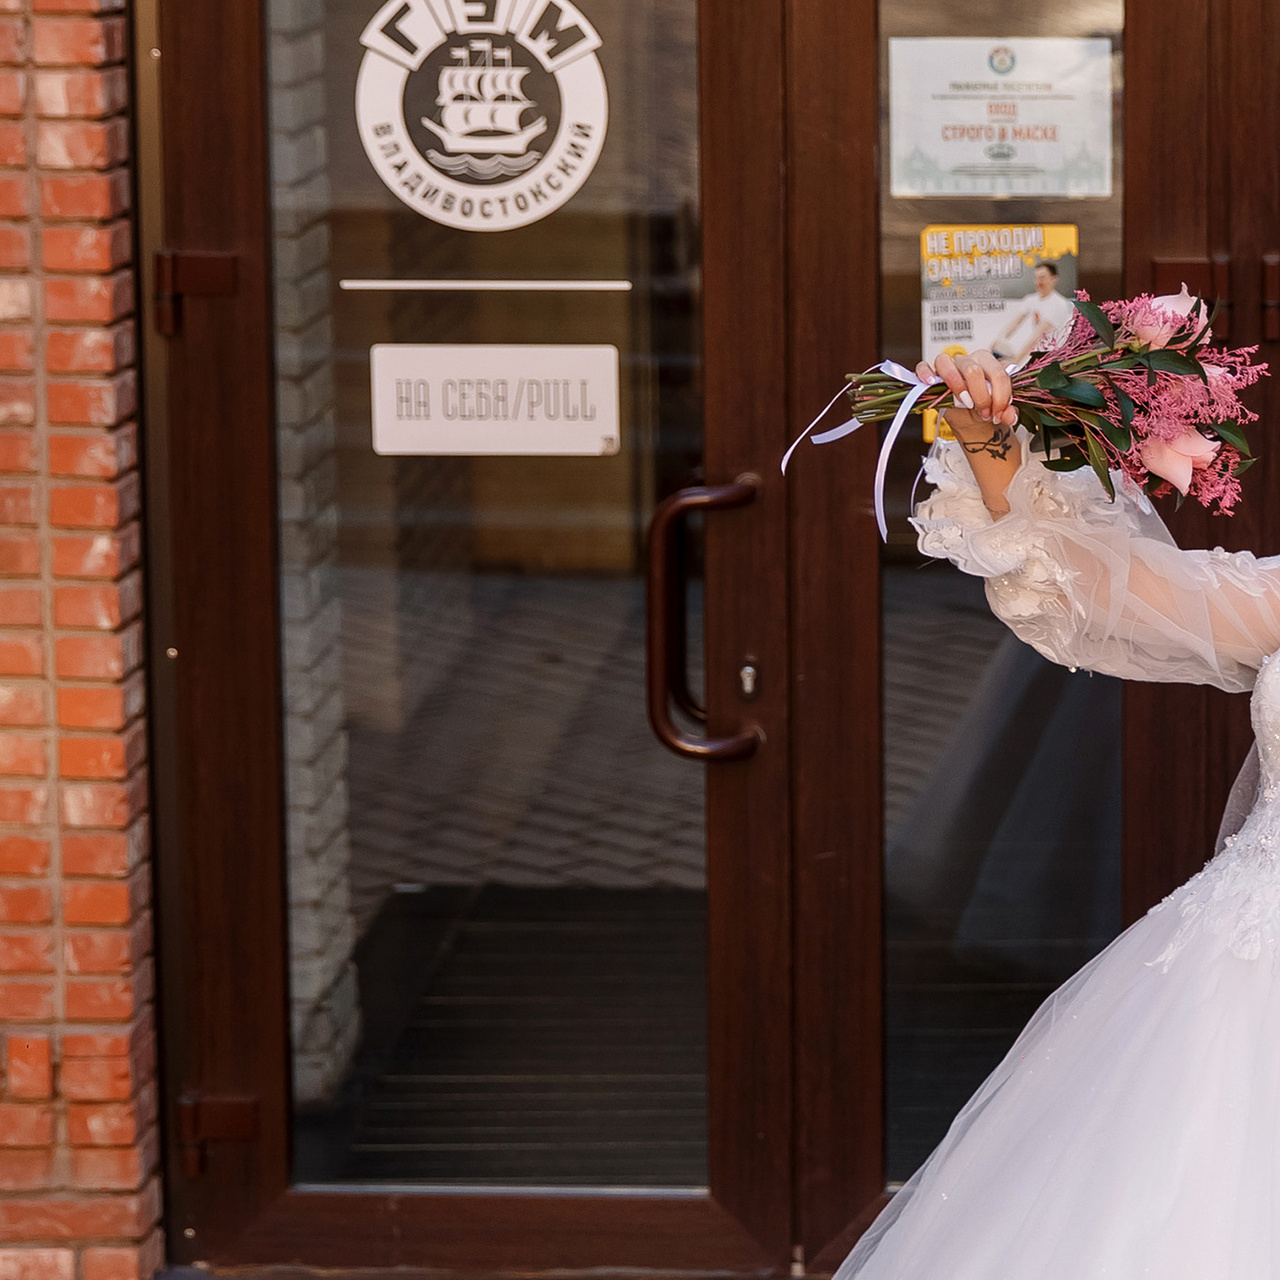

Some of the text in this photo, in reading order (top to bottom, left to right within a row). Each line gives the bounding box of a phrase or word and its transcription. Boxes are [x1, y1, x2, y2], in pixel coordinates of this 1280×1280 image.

[941, 124, 1058, 142] СТРОГО В МАСКЕ
[372, 121, 594, 219] ВЛАДИВОСТОКСКИЙ
[926, 226, 1044, 255] НЕ ПРОХОДИ!
[927, 255, 1022, 282] ЗАНЫРНИ!
[395, 377, 597, 421] НА СЕБЯ/PULL
